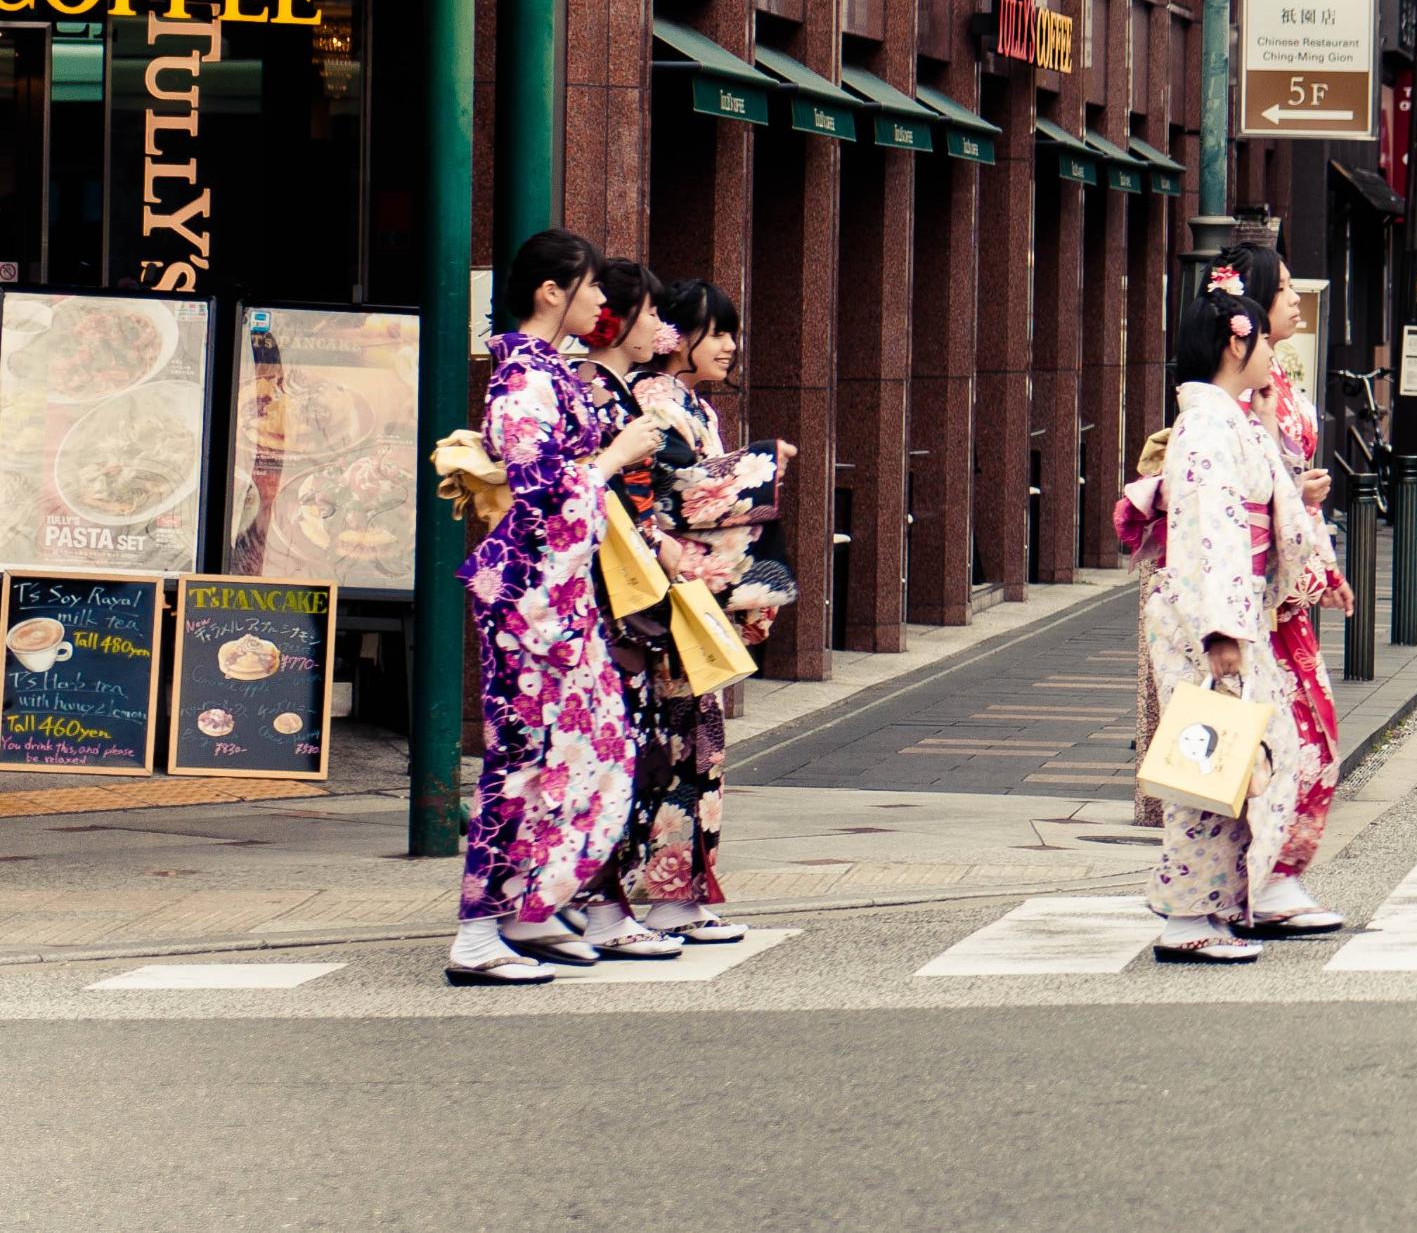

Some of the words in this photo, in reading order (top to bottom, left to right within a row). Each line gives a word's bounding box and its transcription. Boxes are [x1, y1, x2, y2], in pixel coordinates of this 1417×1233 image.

[1036, 6, 1073, 74] COFFEE
[1257, 36, 1300, 48] Chinese
[1302, 36, 1361, 49] Restaurant
[1262, 51, 1324, 65] Ching-Ming
[1327, 51, 1355, 64] Gion
[1287, 75, 1329, 107] 5F
[140, 1, 222, 292] TULLY'S
[44, 525, 114, 549] PASTA
[117, 534, 147, 551] SET
[48, 585, 82, 608] Soy
[57, 609, 98, 625] milk
[73, 630, 97, 650] Tall
[7, 715, 35, 733] Tall
